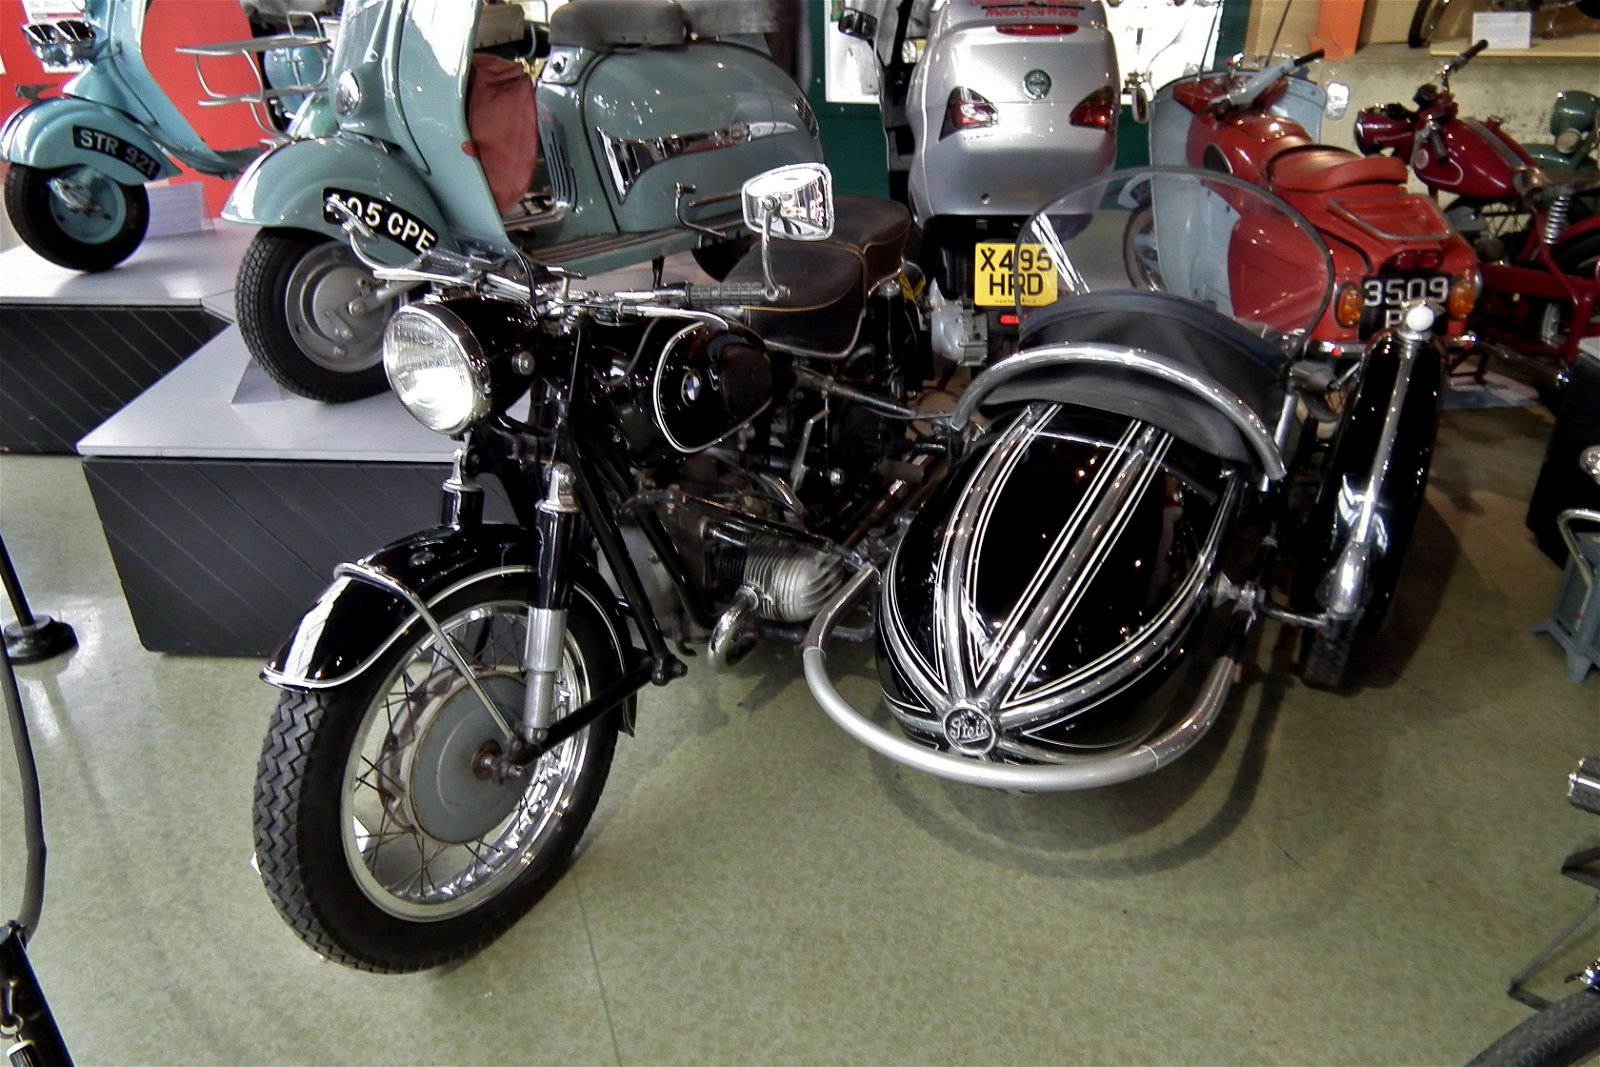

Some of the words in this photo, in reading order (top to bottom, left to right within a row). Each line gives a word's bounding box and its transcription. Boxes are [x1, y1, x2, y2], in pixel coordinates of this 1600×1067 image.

[79, 128, 120, 156] STR
[124, 146, 157, 176] 921
[387, 211, 436, 255] CPE
[980, 248, 1053, 272] X495
[989, 273, 1044, 296] HRD
[1364, 276, 1449, 307] 3509
